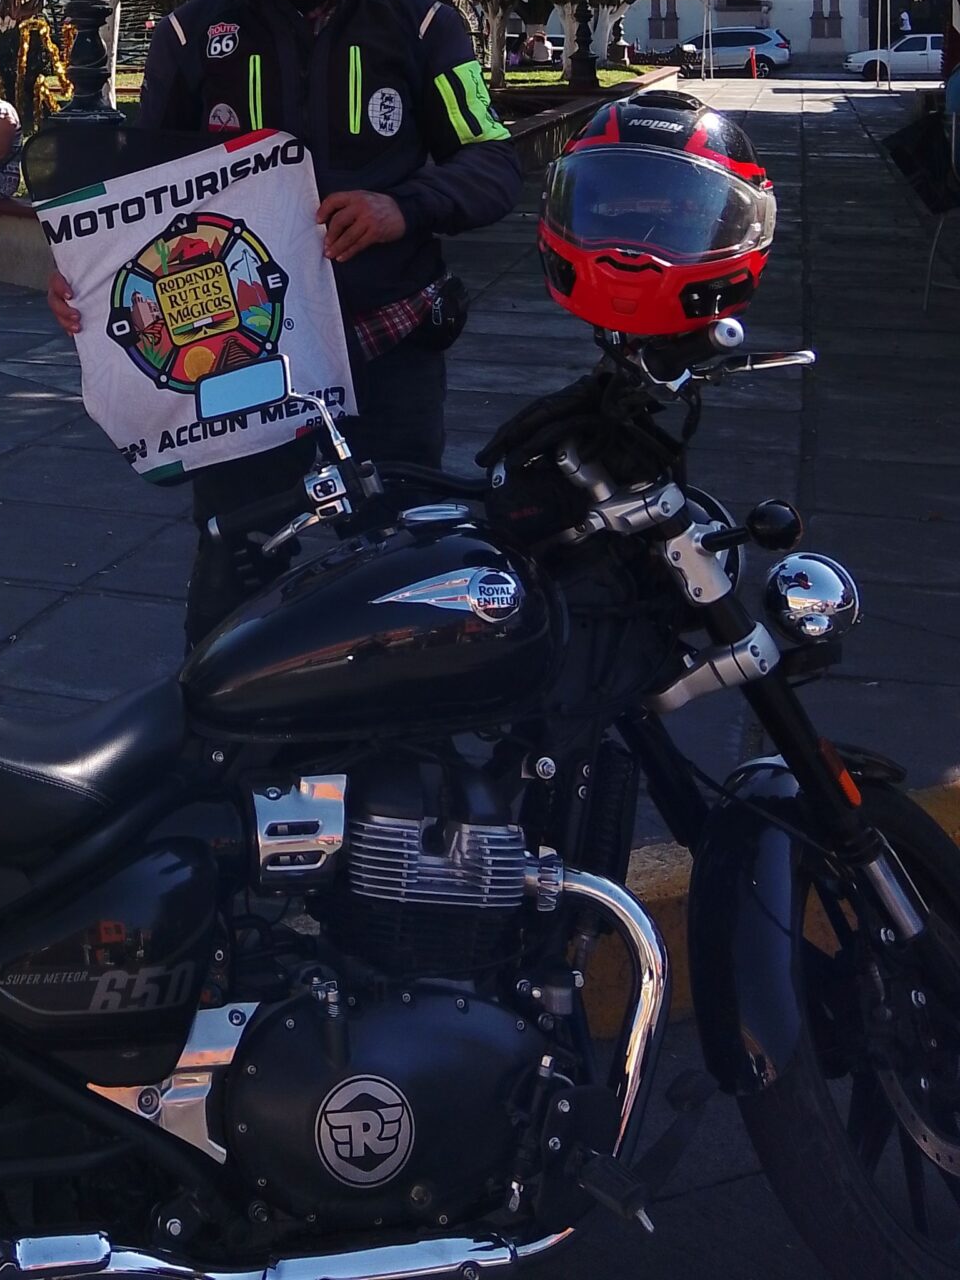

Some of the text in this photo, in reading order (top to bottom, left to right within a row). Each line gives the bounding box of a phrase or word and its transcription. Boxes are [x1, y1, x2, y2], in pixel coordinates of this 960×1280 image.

[210, 34, 234, 55] 66
[628, 118, 685, 133] NOLAN
[41, 139, 306, 245] MOTOTURISMO
[266, 273, 283, 289] E
[478, 584, 512, 597] ROYAL
[476, 595, 517, 608] ENFIELD
[5, 961, 195, 1013] SUPER METEOR 650
